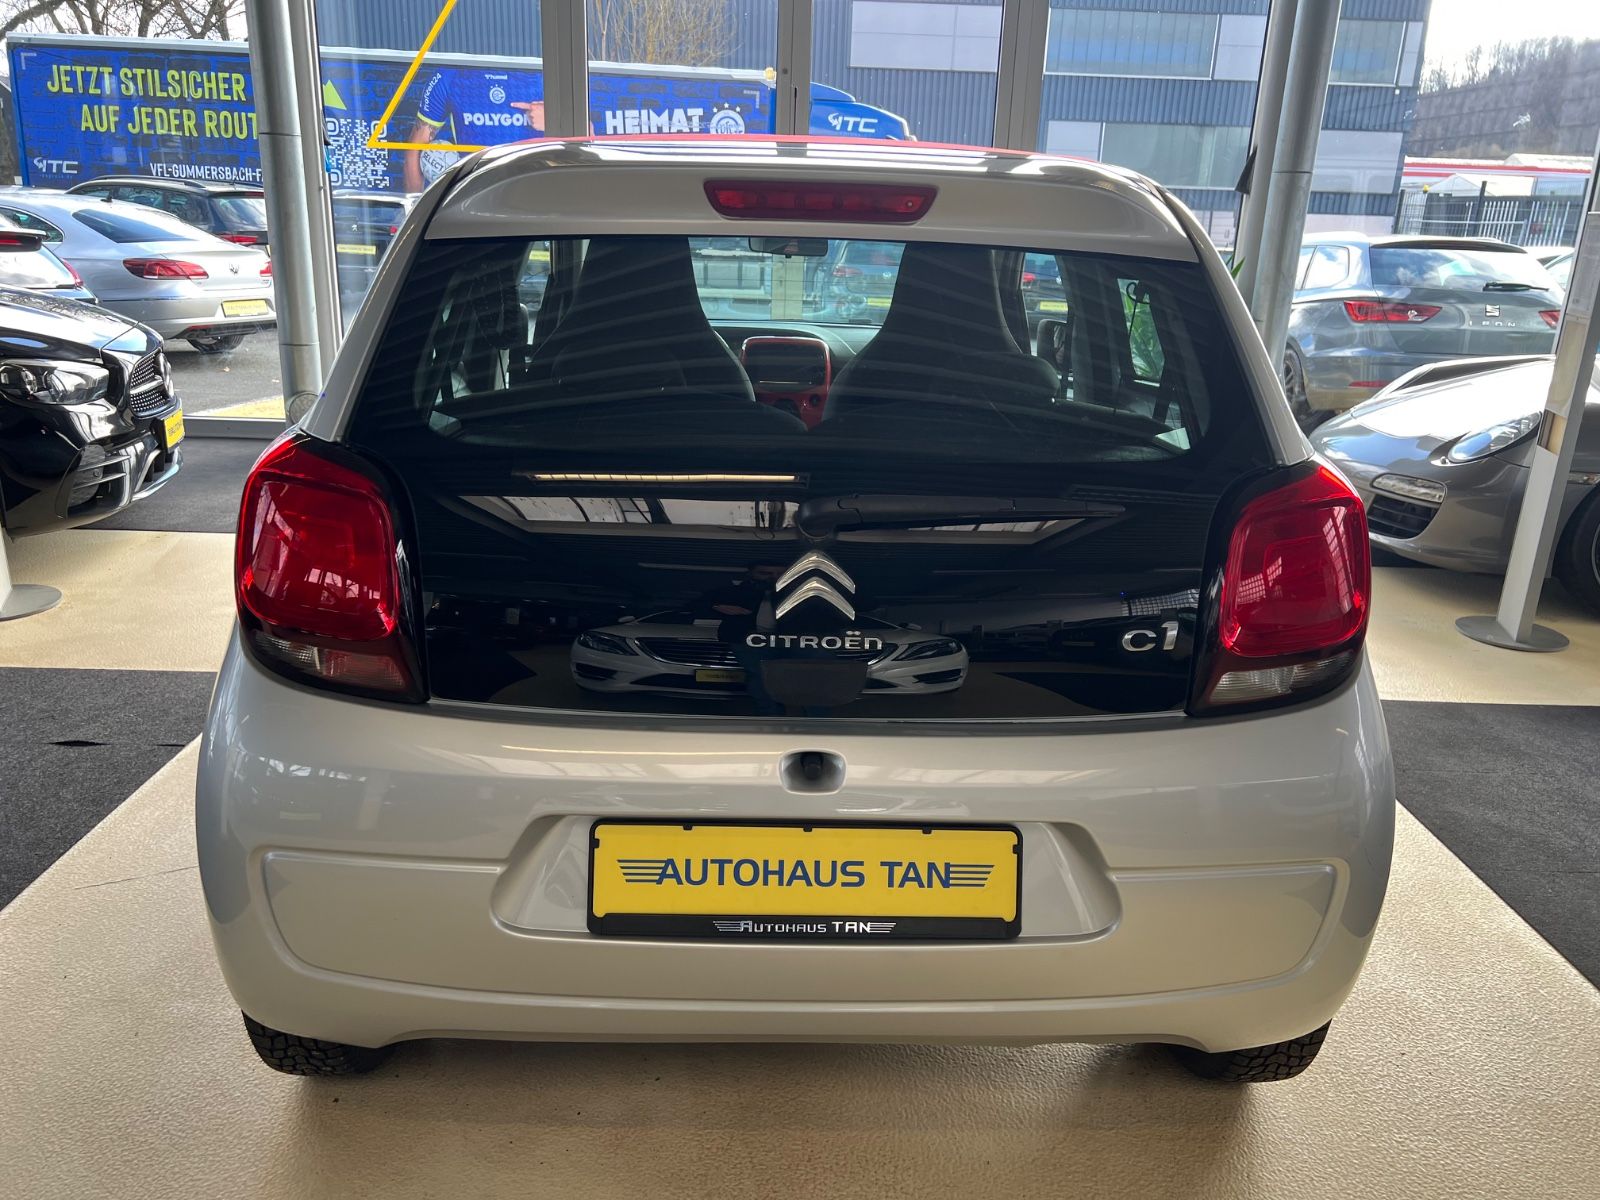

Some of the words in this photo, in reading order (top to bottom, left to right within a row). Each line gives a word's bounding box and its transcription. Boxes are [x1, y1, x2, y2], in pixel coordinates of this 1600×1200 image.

[47, 65, 112, 94] JETZT
[119, 67, 246, 101] STILSICHER
[81, 104, 120, 133] AUF
[127, 106, 199, 137] JEDER
[605, 108, 703, 135] HEIMAT
[149, 163, 264, 182] VFL-GUMMERSBACH-F
[656, 858, 865, 888] AUTOHAUS
[880, 861, 951, 889] TAN
[831, 921, 871, 934] TAN
